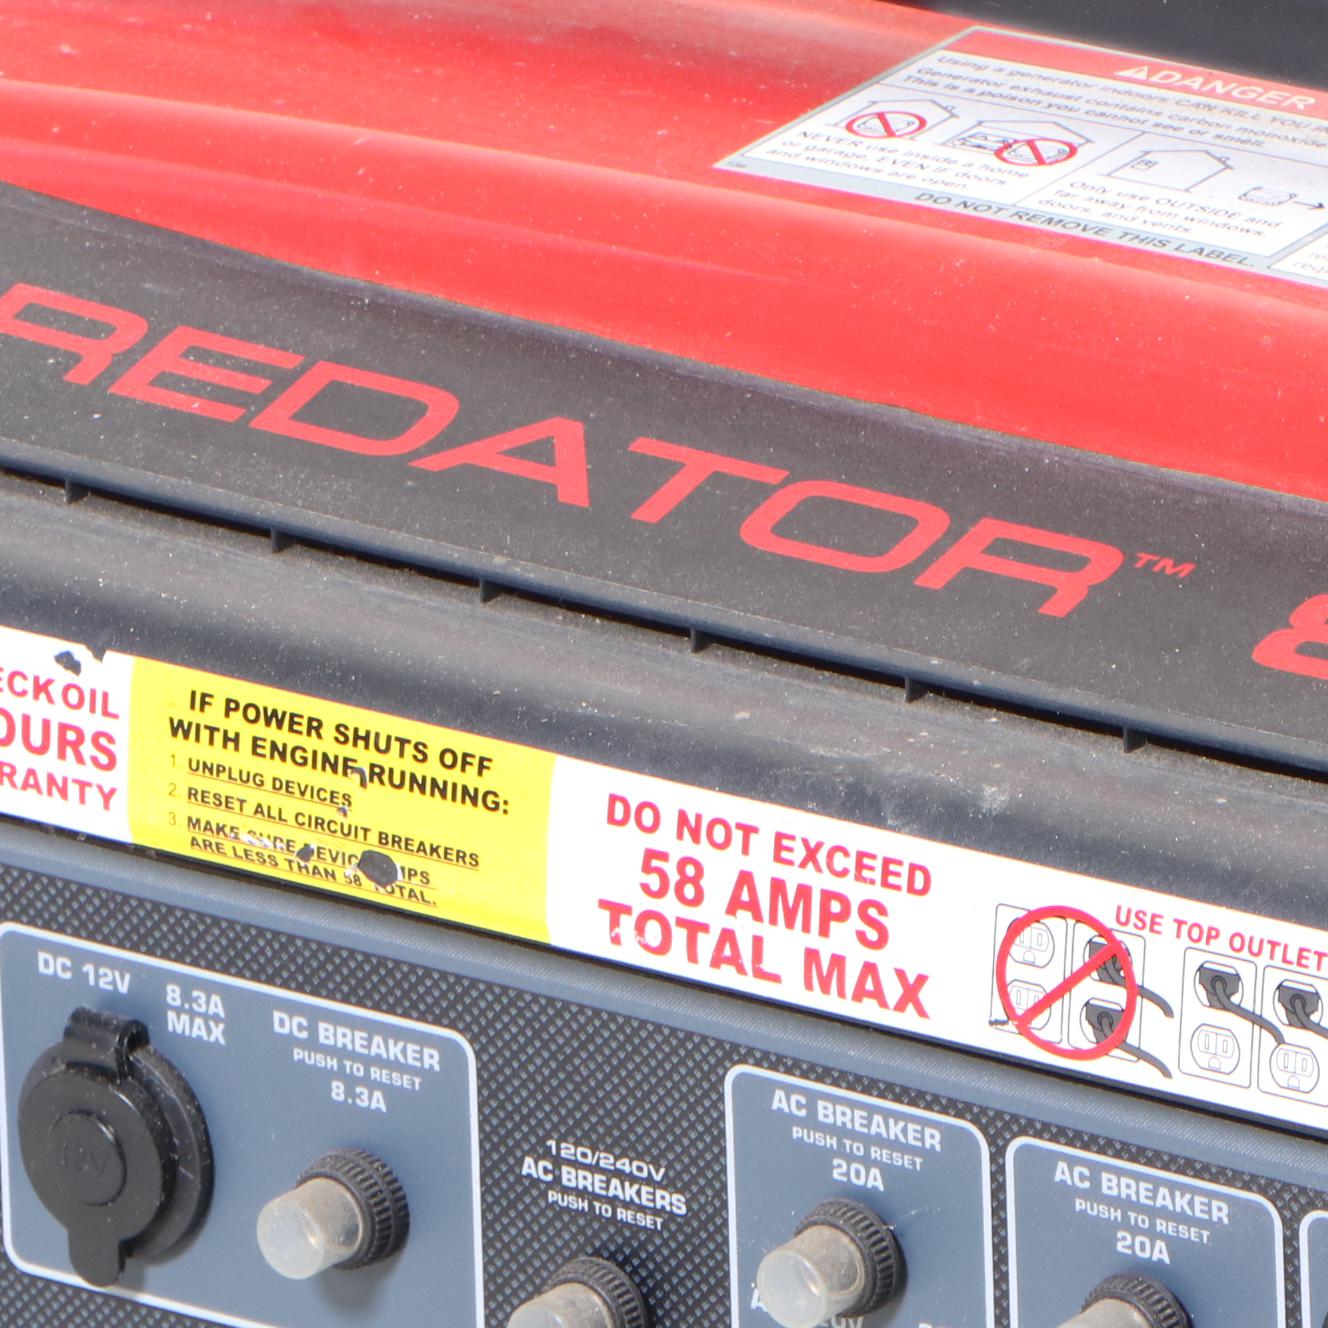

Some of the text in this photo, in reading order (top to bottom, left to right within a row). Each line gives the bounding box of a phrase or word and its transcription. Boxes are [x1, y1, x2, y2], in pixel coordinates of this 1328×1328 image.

[1149, 70, 1316, 109] DANGER
[915, 192, 952, 205] DO
[958, 201, 1009, 216] NOT
[1012, 210, 1111, 237] REMOVE
[1119, 231, 1173, 249] THIS
[61, 683, 120, 719] OIL
[190, 690, 493, 777] IF POWER SHUTS OFF
[169, 717, 240, 751] WITH
[368, 763, 509, 814] RUNNING:
[188, 758, 264, 787] UNPLUG
[272, 777, 352, 807] DEVICES
[187, 816, 239, 840] MAKE
[188, 787, 247, 812] RESET
[254, 802, 288, 822] ALL
[295, 811, 371, 842] CIRCUIT
[378, 831, 480, 868] BREAKERS
[607, 793, 931, 896] DO NOT EXCEED
[190, 836, 225, 856] ARE
[232, 845, 279, 867] LESS
[284, 858, 336, 881] THAN
[640, 848, 890, 951] 58 AMPS
[1115, 905, 1164, 935] USE
[1173, 919, 1221, 946] TOP
[37, 951, 130, 994] DC 12V
[598, 898, 930, 1019] TOTAL MAX
[166, 984, 225, 1018] 8.3A
[167, 1010, 226, 1045] MAX
[273, 1009, 440, 1071] DC BREAKER
[293, 1047, 421, 1091] PUSH TO RESET
[331, 1081, 387, 1112] 8.3A
[772, 1089, 942, 1152] AC BREAKER
[546, 1139, 665, 1182] 120/240V
[792, 1126, 923, 1171] PUSH TO RESET
[522, 1156, 687, 1216] AC BREAKERS
[832, 1158, 884, 1192] 20A
[1054, 1161, 1229, 1225] AC BREAKER
[548, 1190, 664, 1231] PUSH TO RESET
[1075, 1198, 1210, 1245] PUSH TO RESET
[1116, 1231, 1171, 1264] 20A
